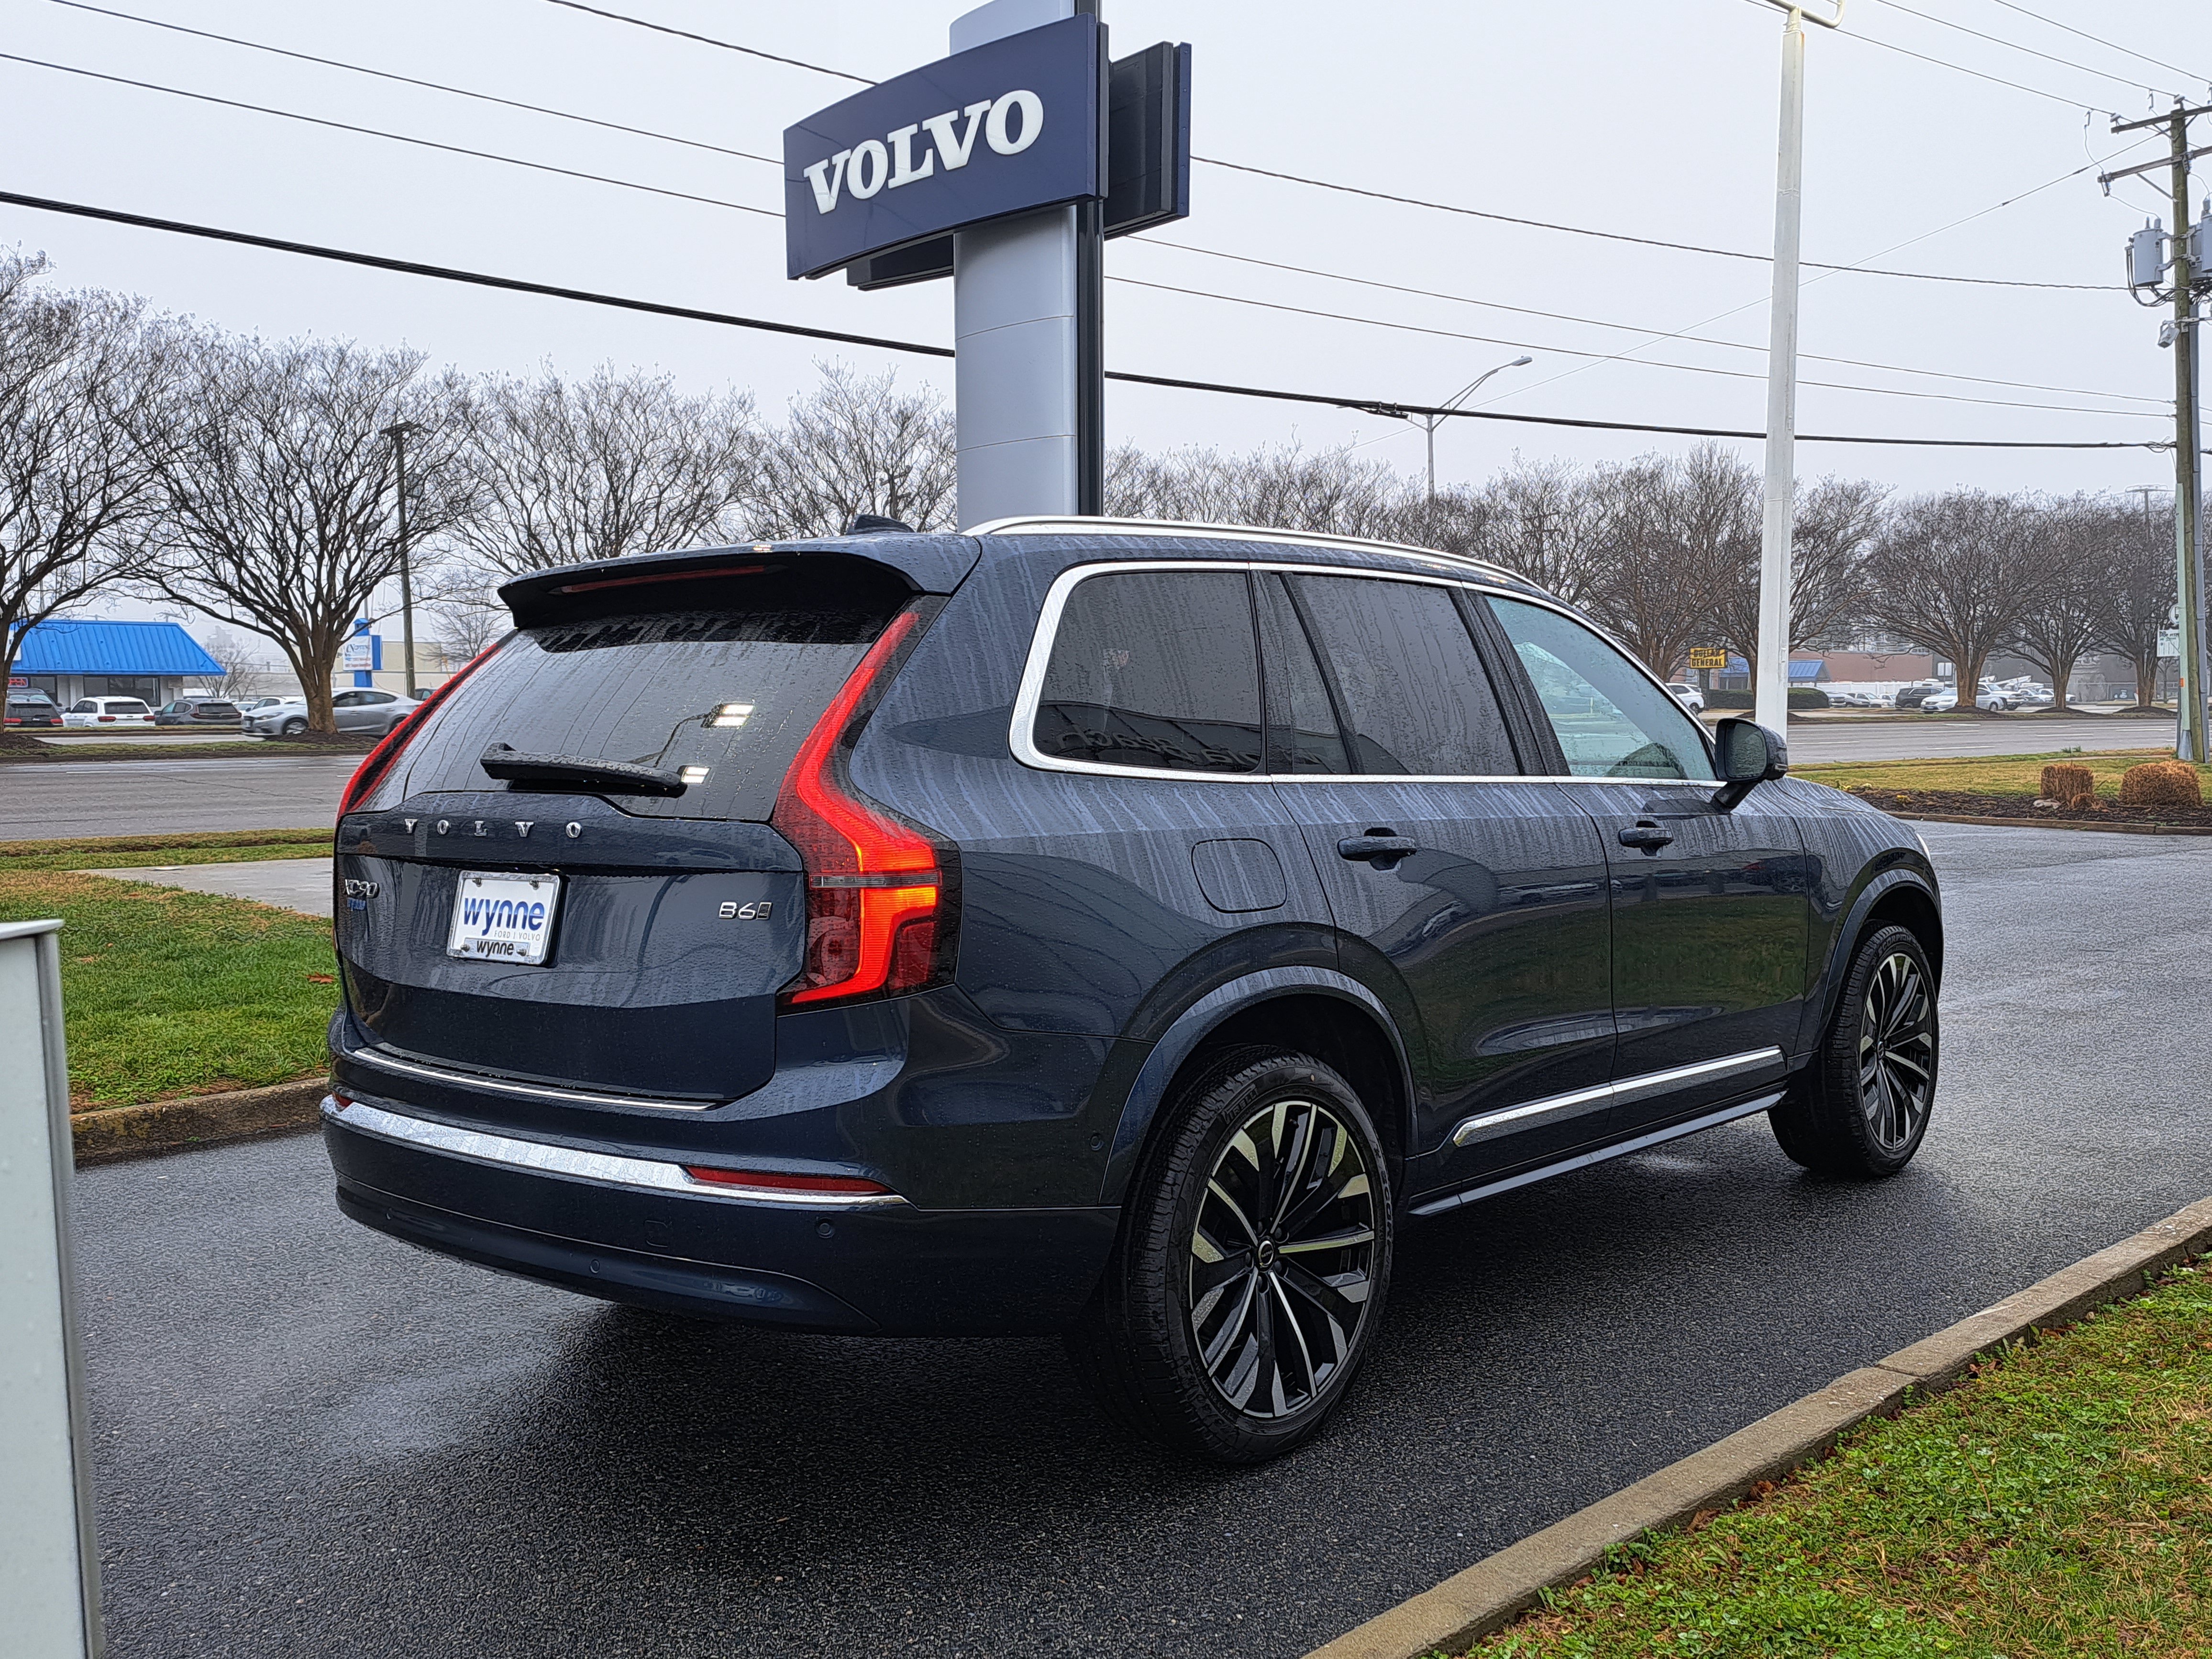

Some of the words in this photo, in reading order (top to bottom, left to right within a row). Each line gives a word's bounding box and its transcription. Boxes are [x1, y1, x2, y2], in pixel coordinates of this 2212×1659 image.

[803, 89, 1044, 214] VOLVO
[1692, 658, 1723, 666] GENERAL
[404, 818, 583, 839] VOLVO
[343, 879, 377, 897] XC90
[464, 897, 544, 936] wynne
[719, 902, 756, 919] B6
[494, 930, 510, 939] FORD
[476, 940, 514, 957] wynne
